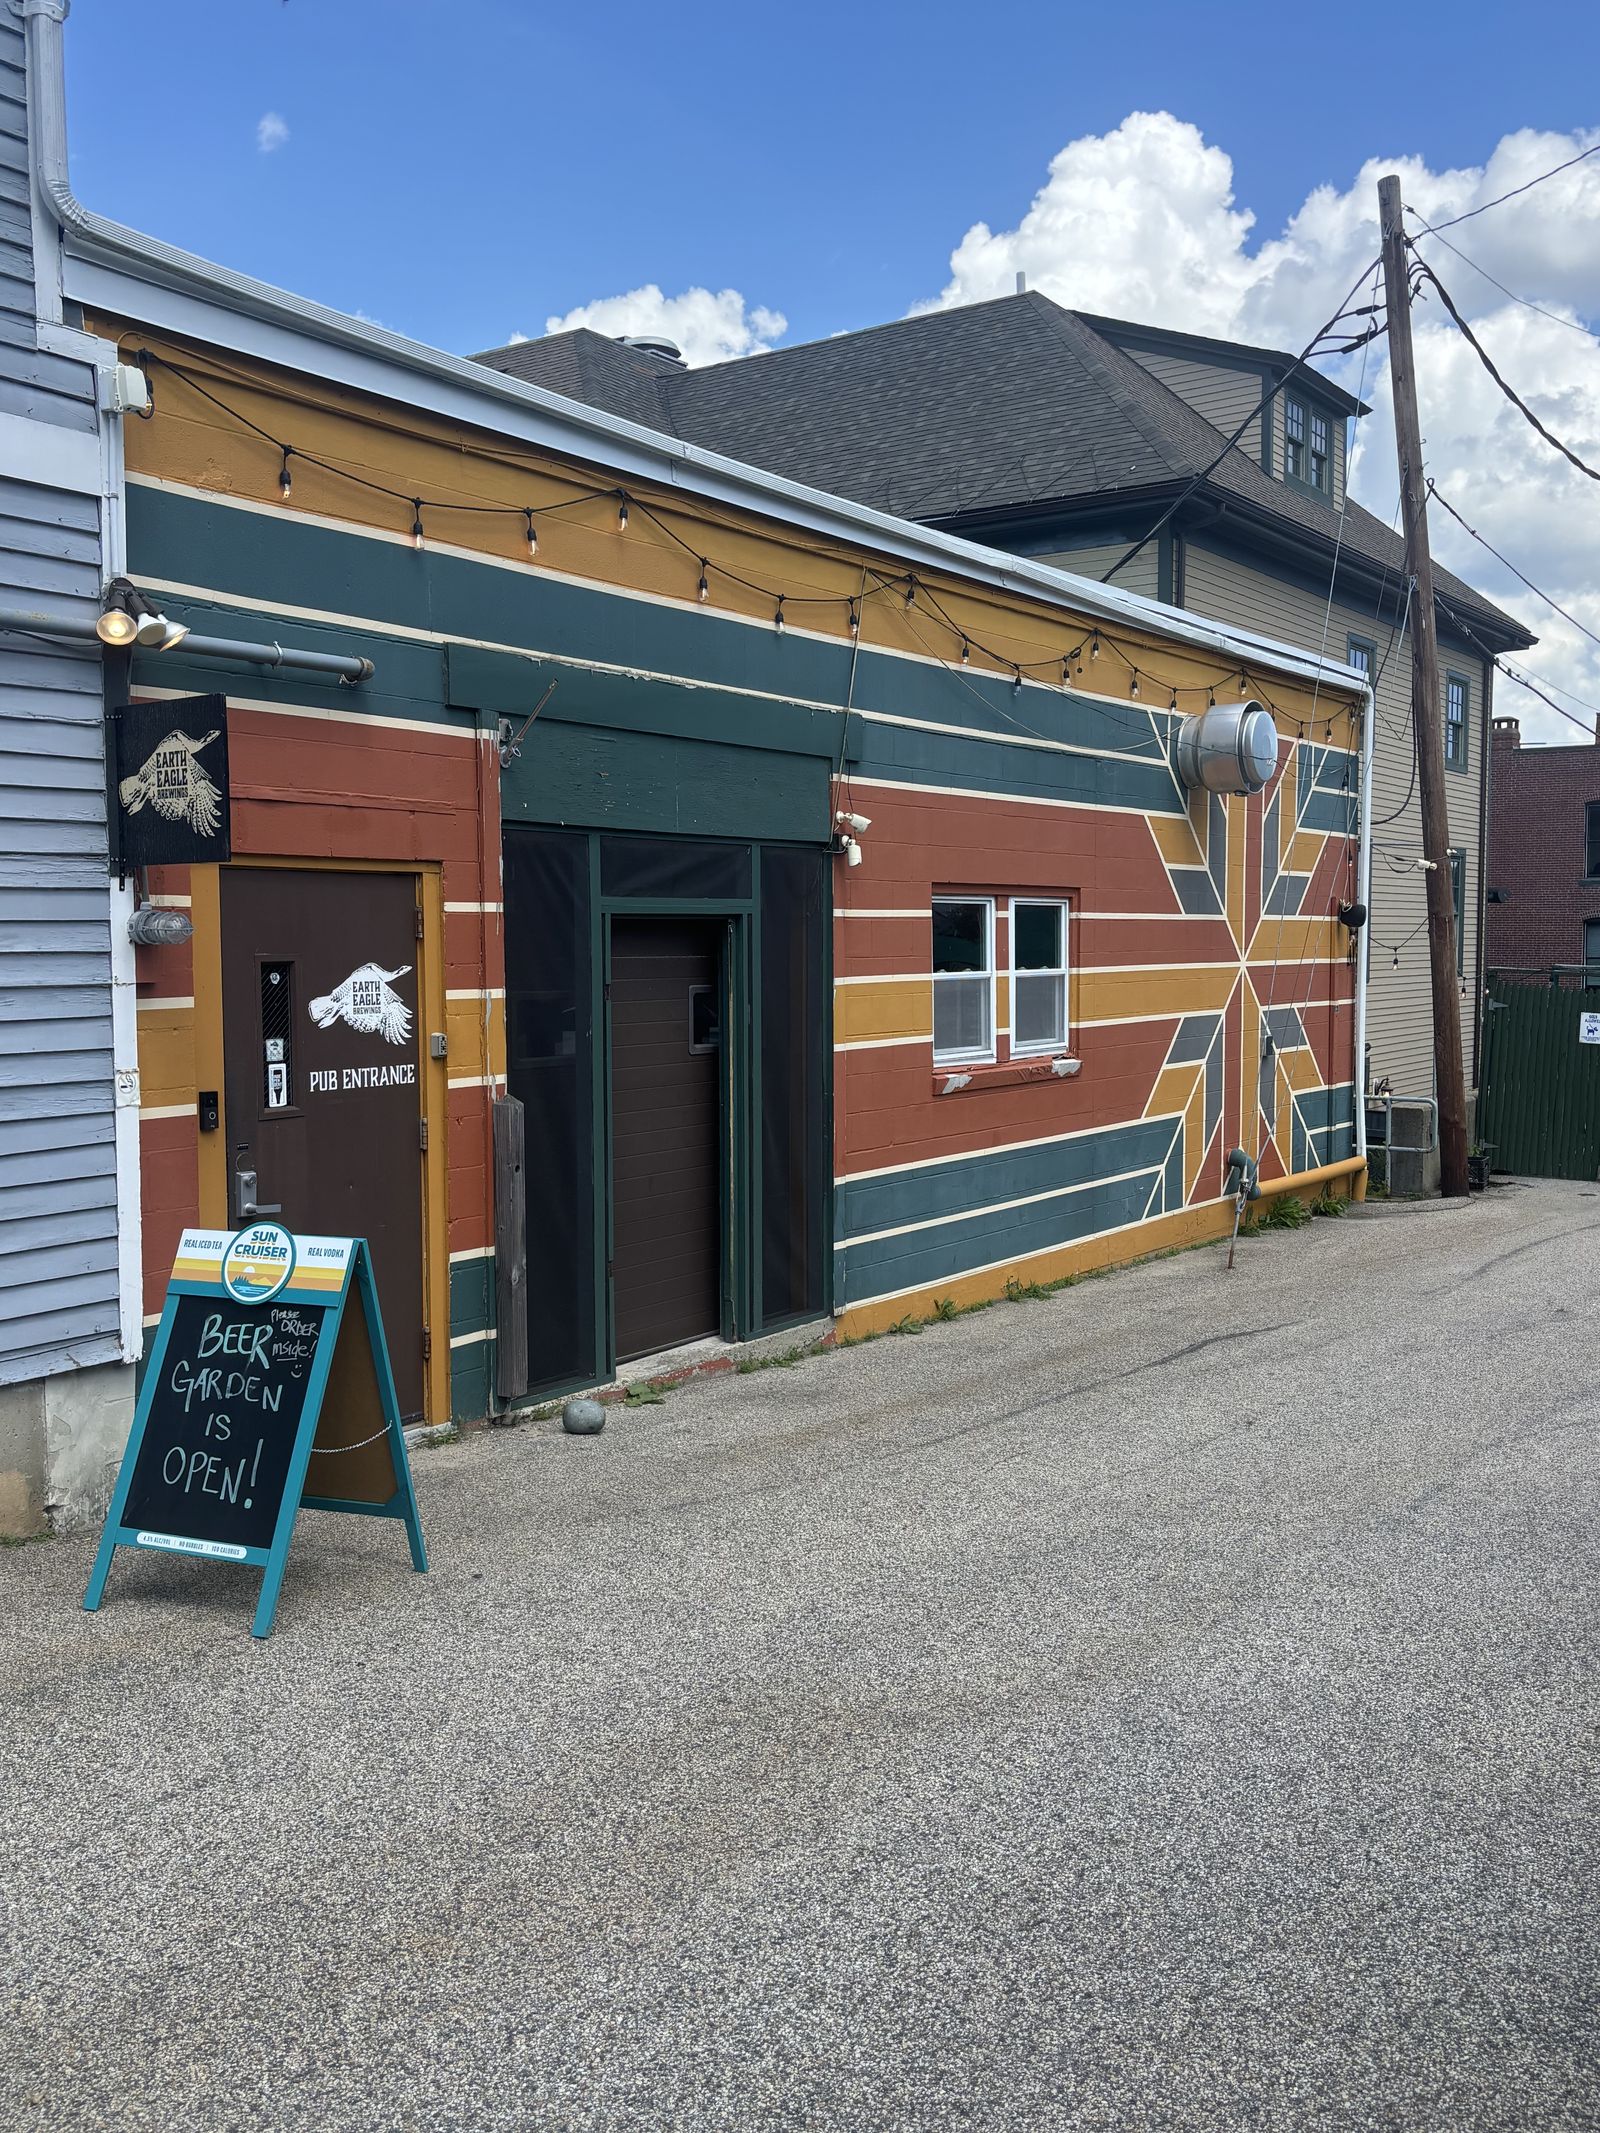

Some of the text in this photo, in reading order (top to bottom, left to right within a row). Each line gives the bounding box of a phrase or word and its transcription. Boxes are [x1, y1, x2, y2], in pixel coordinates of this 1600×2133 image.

[156, 750, 187, 768] EARTH
[156, 768, 188, 788] EAGLE
[157, 787, 189, 800] BREWINGS
[352, 981, 381, 993] EARTH
[353, 993, 381, 1006] EAGLE
[353, 1006, 382, 1015] BREWINGS
[310, 1064, 415, 1092] PUB ENTRANCE
[251, 1230, 279, 1243] SUN
[183, 1239, 223, 1250] REAL ICED TEA
[234, 1243, 288, 1259] CRUISER
[307, 1247, 345, 1258] REAL VODKA
[271, 1309, 300, 1323] Please
[281, 1319, 319, 1336] ORDER
[198, 1314, 273, 1369] BEER
[171, 1360, 283, 1412] GARDEN
[205, 1413, 231, 1441] IS
[162, 1438, 264, 1509] OPEN!
[220, 1546, 240, 1556] CALORIES
